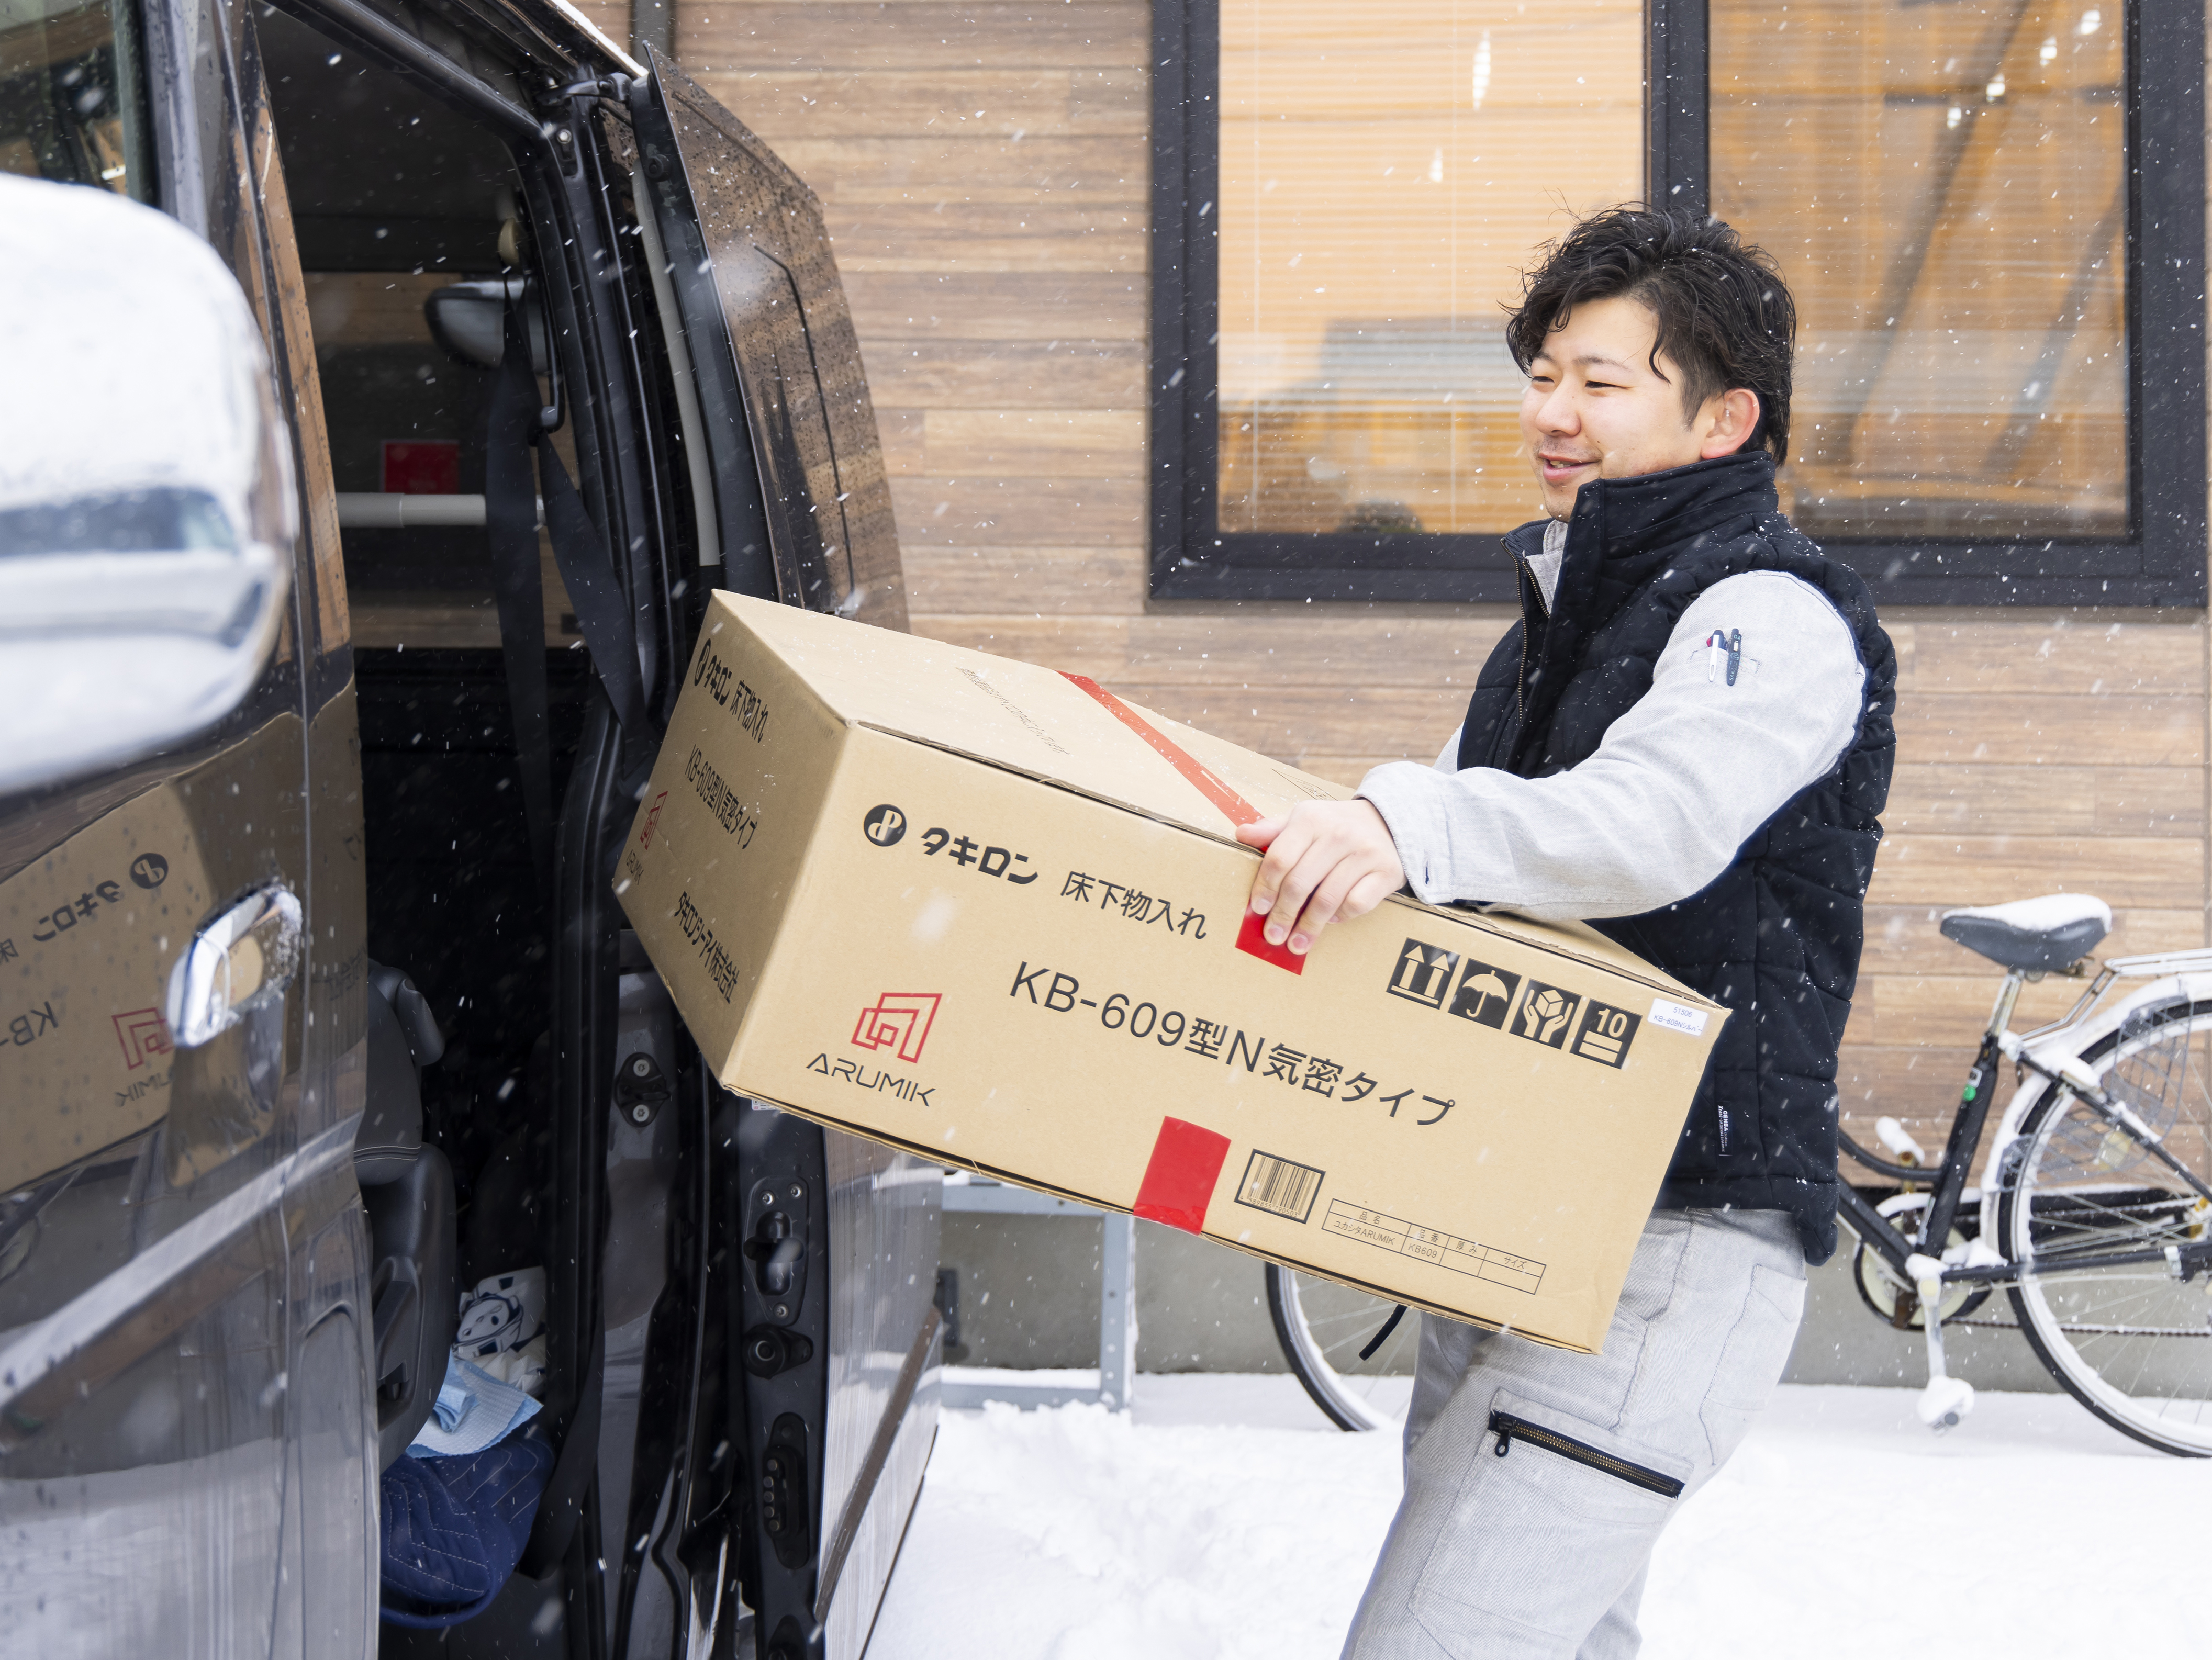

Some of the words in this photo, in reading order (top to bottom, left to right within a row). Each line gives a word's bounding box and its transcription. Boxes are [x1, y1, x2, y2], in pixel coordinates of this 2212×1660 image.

[703, 655, 732, 706] タキロン
[729, 680, 768, 743] 床下物入れ
[685, 744, 757, 849] KB-609型N気密タイプ
[921, 827, 1038, 884] タキロン
[1060, 871, 1207, 940] 床下物入れ
[1597, 1008, 1628, 1038] 10
[1673, 1007, 1693, 1017] 51506
[1009, 961, 1456, 1126] KB-609型N気密タイプ
[806, 1052, 936, 1106] ARUMIK
[1248, 1197, 1272, 1209] 589855
[1273, 1205, 1299, 1217] 790503
[1333, 1220, 1396, 1246] ユカシタARUMIK
[1407, 1243, 1438, 1259] KB609
[1504, 1256, 1528, 1269] サイズ
